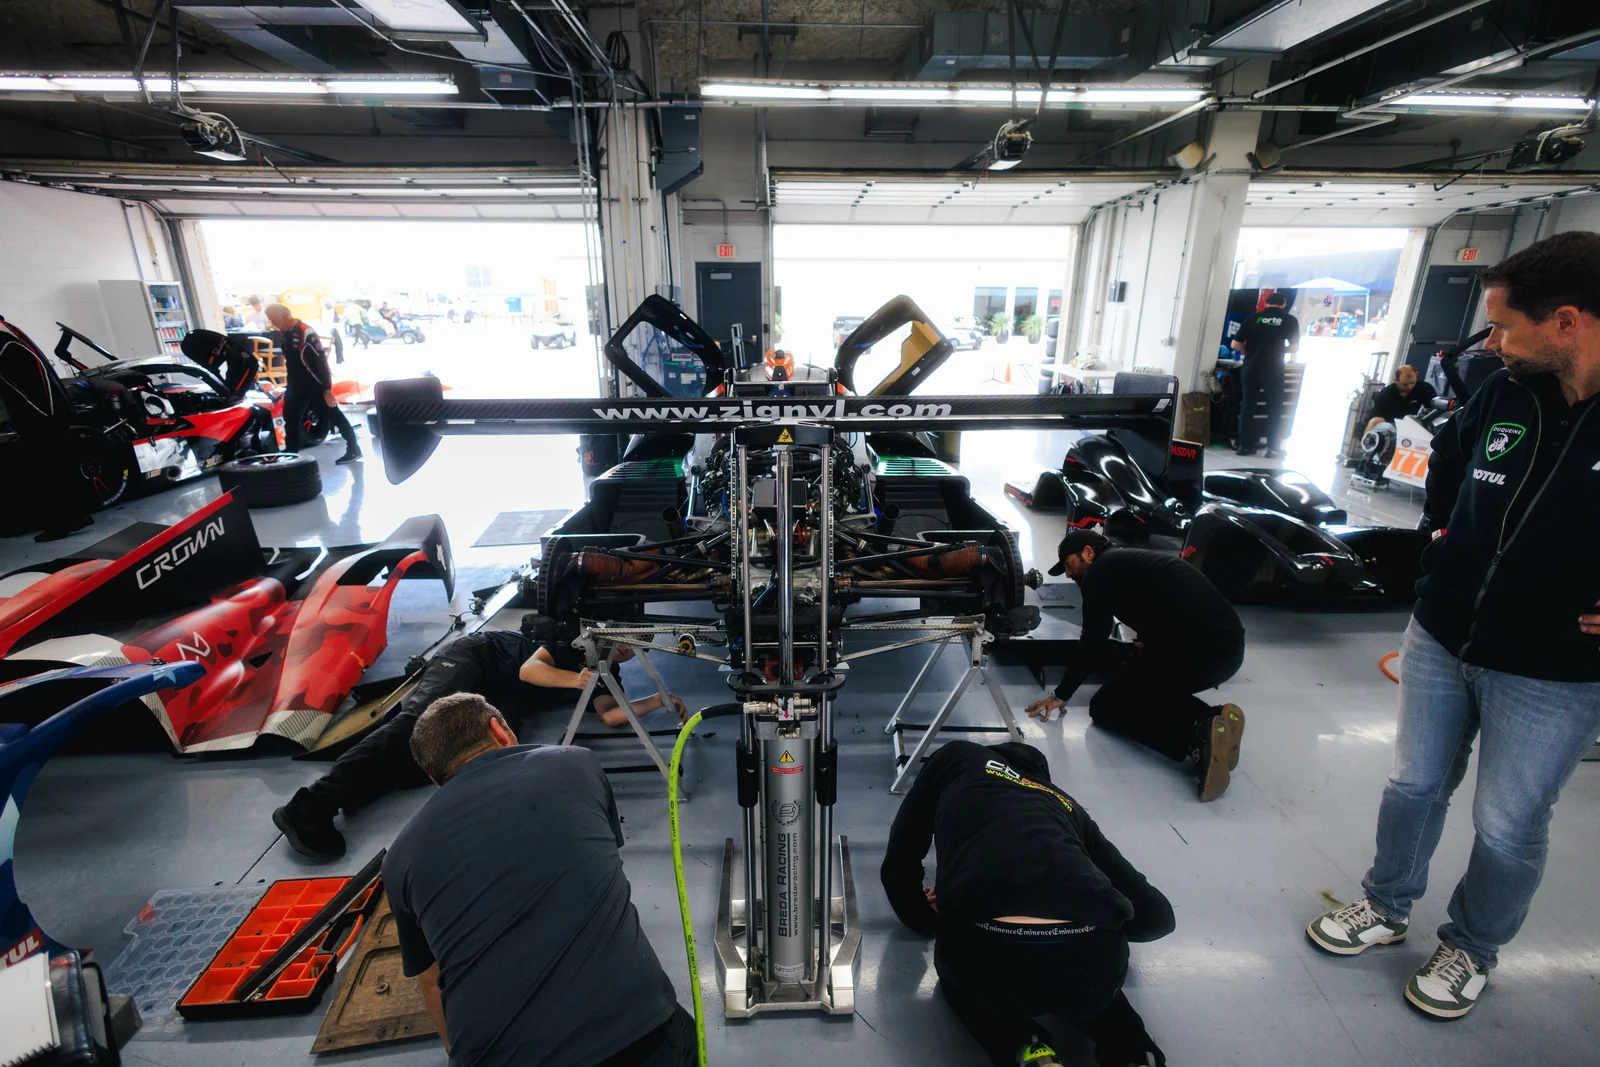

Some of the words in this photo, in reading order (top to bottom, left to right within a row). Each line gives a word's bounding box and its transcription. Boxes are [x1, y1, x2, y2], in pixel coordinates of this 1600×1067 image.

[719, 245, 734, 257] EXIT
[1462, 248, 1479, 261] EXIT
[1493, 426, 1522, 436] DUQUEINE
[1397, 449, 1427, 475] 77
[136, 516, 226, 590] CROWN
[777, 832, 787, 886] RACING
[791, 832, 800, 937] www.bredaracing.com
[778, 891, 788, 937] BREDA
